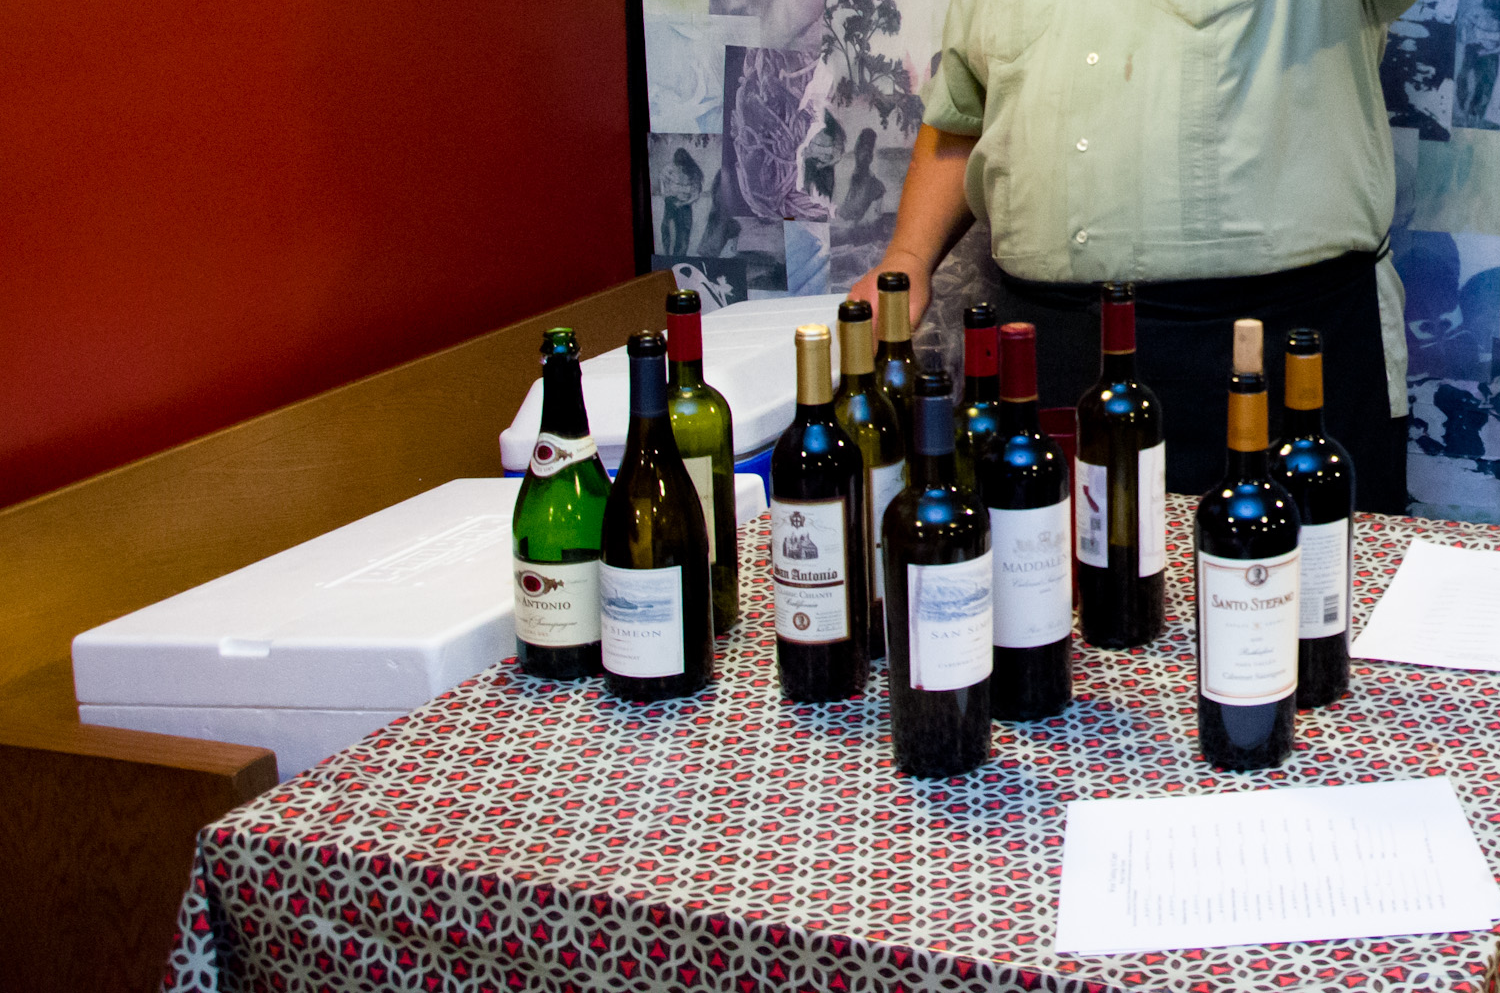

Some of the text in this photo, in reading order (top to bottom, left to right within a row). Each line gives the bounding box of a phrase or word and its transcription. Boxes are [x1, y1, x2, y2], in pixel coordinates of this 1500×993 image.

[1002, 553, 1068, 573] MADDALEN
[791, 568, 839, 582] Antonio
[522, 596, 571, 611] ANTONIO
[1211, 593, 1249, 611] SANTO
[610, 627, 662, 639] SIMEON
[930, 628, 961, 640] SAN
